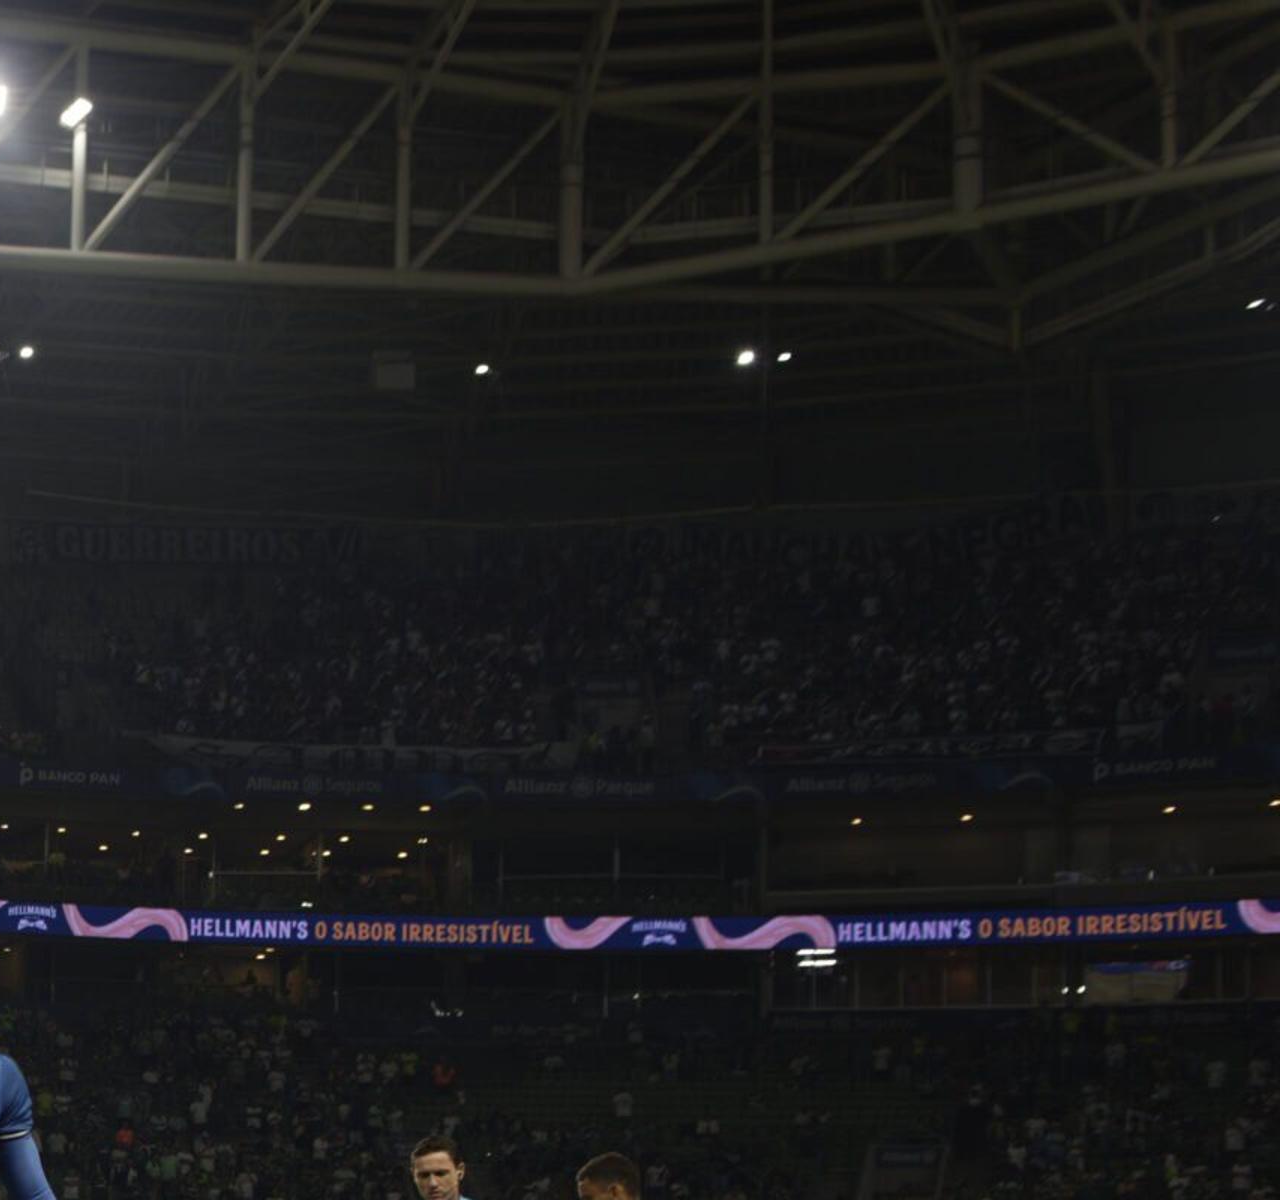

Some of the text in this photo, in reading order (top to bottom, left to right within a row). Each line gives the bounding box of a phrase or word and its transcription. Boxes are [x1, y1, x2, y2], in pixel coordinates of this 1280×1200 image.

[56, 525, 302, 563] GUERREIROS
[37, 769, 121, 786] BANCO PAN
[245, 777, 382, 796] Allianz Seguros
[786, 776, 846, 793] Allianz
[504, 778, 655, 797] Allianz Parque
[7, 903, 57, 919] HELLMANN'S
[189, 917, 535, 944] HELLMANN'S O SABOR IRRESISTÍVEL
[631, 918, 688, 935] HELLMANN'S
[838, 904, 1228, 943] HELLMANN'S O SABOR IRRESISTÍVEL
